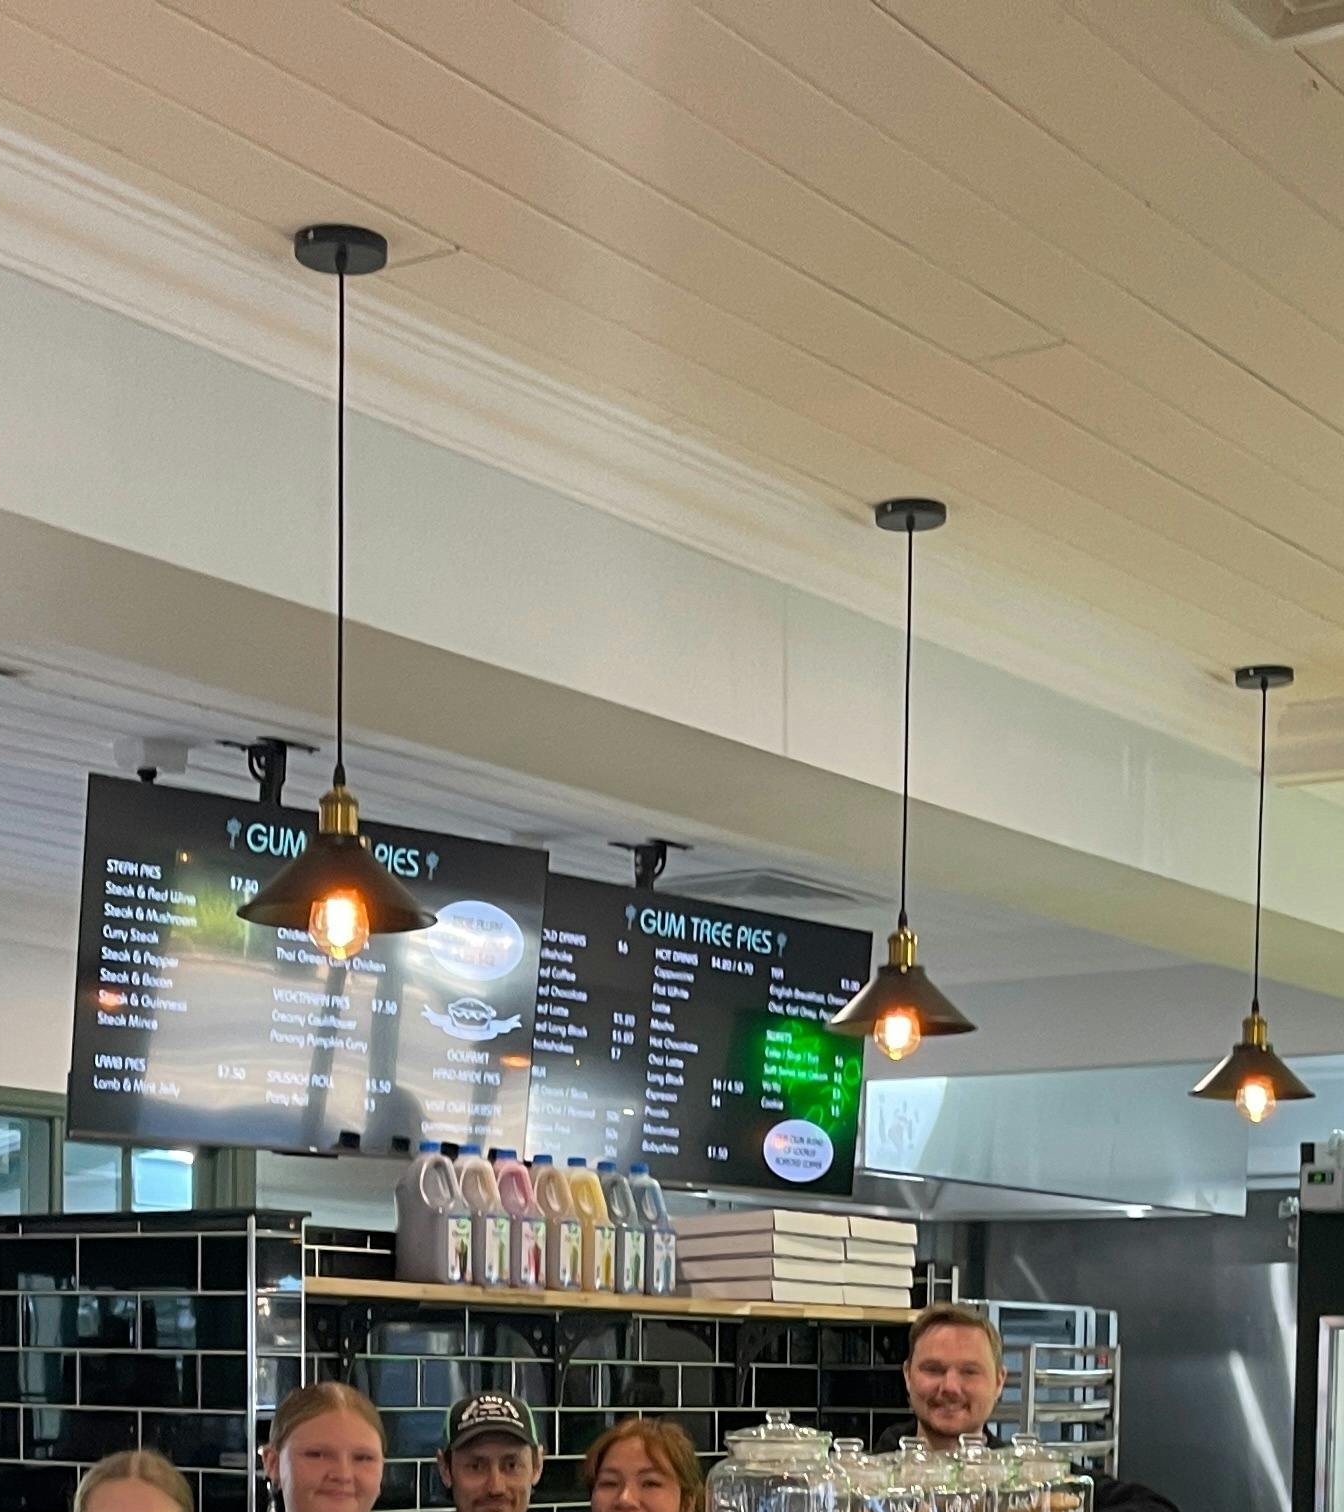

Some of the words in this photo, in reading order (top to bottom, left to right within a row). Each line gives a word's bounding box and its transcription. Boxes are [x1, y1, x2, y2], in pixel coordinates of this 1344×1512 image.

[246, 823, 306, 858] GUM
[107, 859, 138, 877] STEAK
[140, 864, 162, 880] PIES
[106, 881, 135, 898] Steak
[148, 887, 168, 903] Red
[170, 890, 196, 906] Wine
[104, 903, 133, 920] Steak
[146, 908, 197, 927] Mushroom
[103, 925, 128, 943] Curry
[130, 927, 159, 944] Steak
[640, 908, 685, 940] GUM
[690, 916, 732, 948] TREE
[737, 926, 772, 954] PIES
[102, 947, 130, 964] Steak
[143, 951, 178, 969] Pepper
[276, 947, 295, 961] Thai
[298, 950, 327, 966] Green
[353, 957, 386, 973] Chicken
[100, 968, 129, 985] Steak
[142, 973, 173, 989] Bacon
[97, 1011, 127, 1027] Steak
[128, 1014, 158, 1030] Mince
[272, 1009, 306, 1026] Creamy
[308, 1013, 357, 1030] Cauliflower
[307, 1033, 344, 1050] Pumpkin
[346, 1036, 368, 1053] Curry
[95, 1054, 123, 1070] LAMB
[94, 1075, 121, 1091] Lamb
